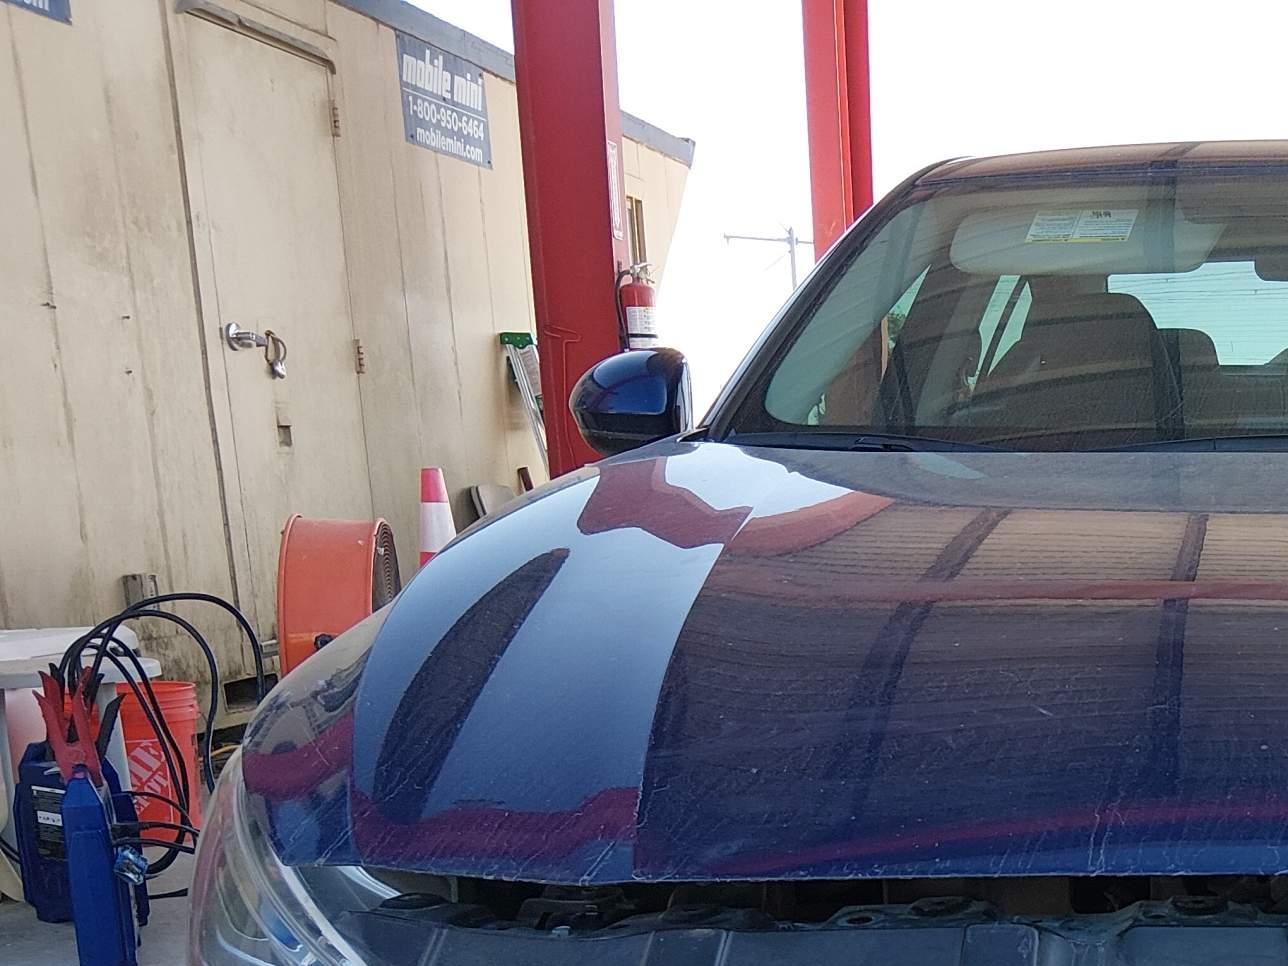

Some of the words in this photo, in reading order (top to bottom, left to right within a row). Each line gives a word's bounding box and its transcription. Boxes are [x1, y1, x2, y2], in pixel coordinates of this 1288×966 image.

[402, 48, 452, 100] mobile
[453, 72, 483, 111] mini
[408, 95, 485, 141] 1-800-950-6464
[416, 127, 484, 163] mobilemini.com
